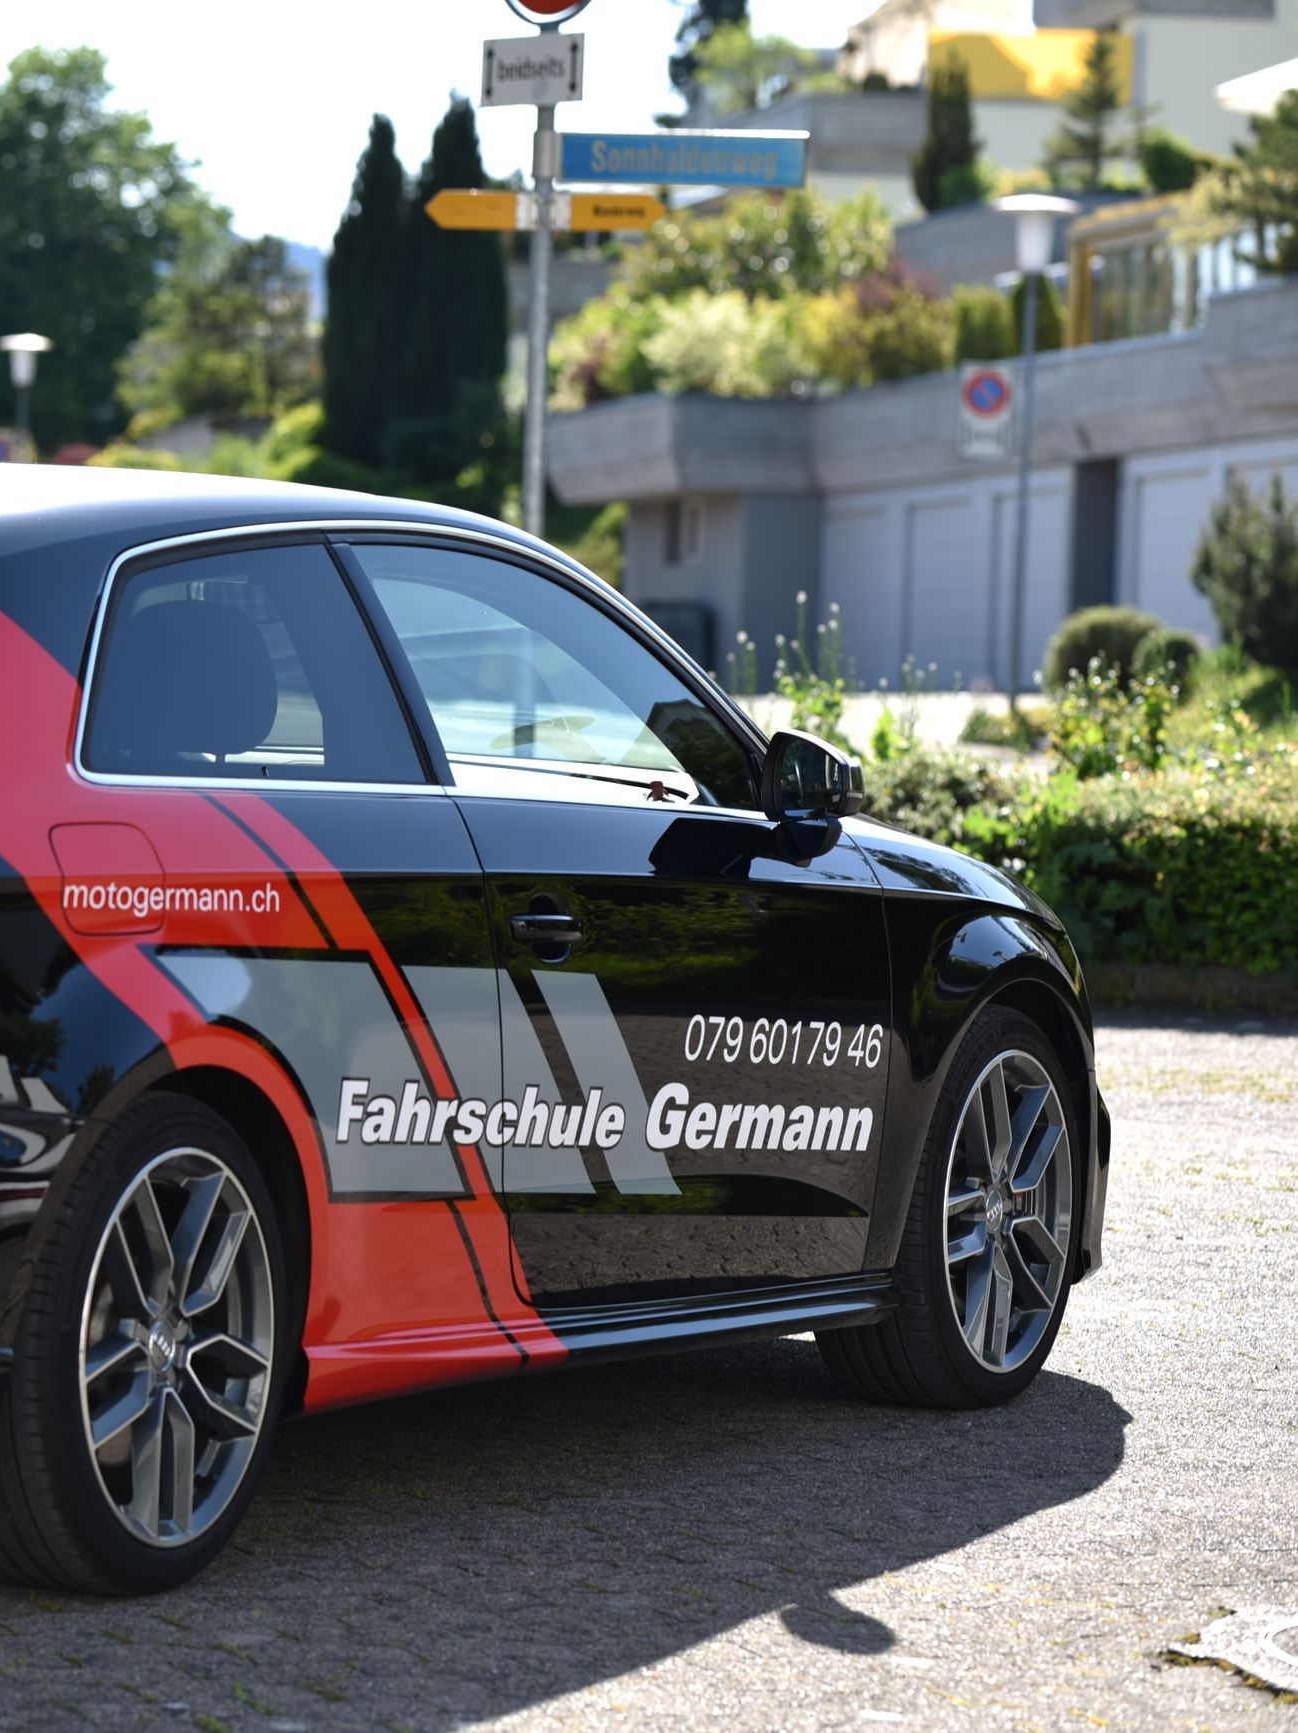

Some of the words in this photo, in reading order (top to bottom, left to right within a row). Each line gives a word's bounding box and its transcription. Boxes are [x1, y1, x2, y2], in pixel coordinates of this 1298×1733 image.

[497, 55, 565, 81] beidseits
[62, 882, 281, 918] motogermann.ch
[684, 1014, 744, 1063] 079
[847, 1024, 884, 1068] 46
[335, 1077, 625, 1149] Fahrschule
[646, 1082, 874, 1151] Germann
